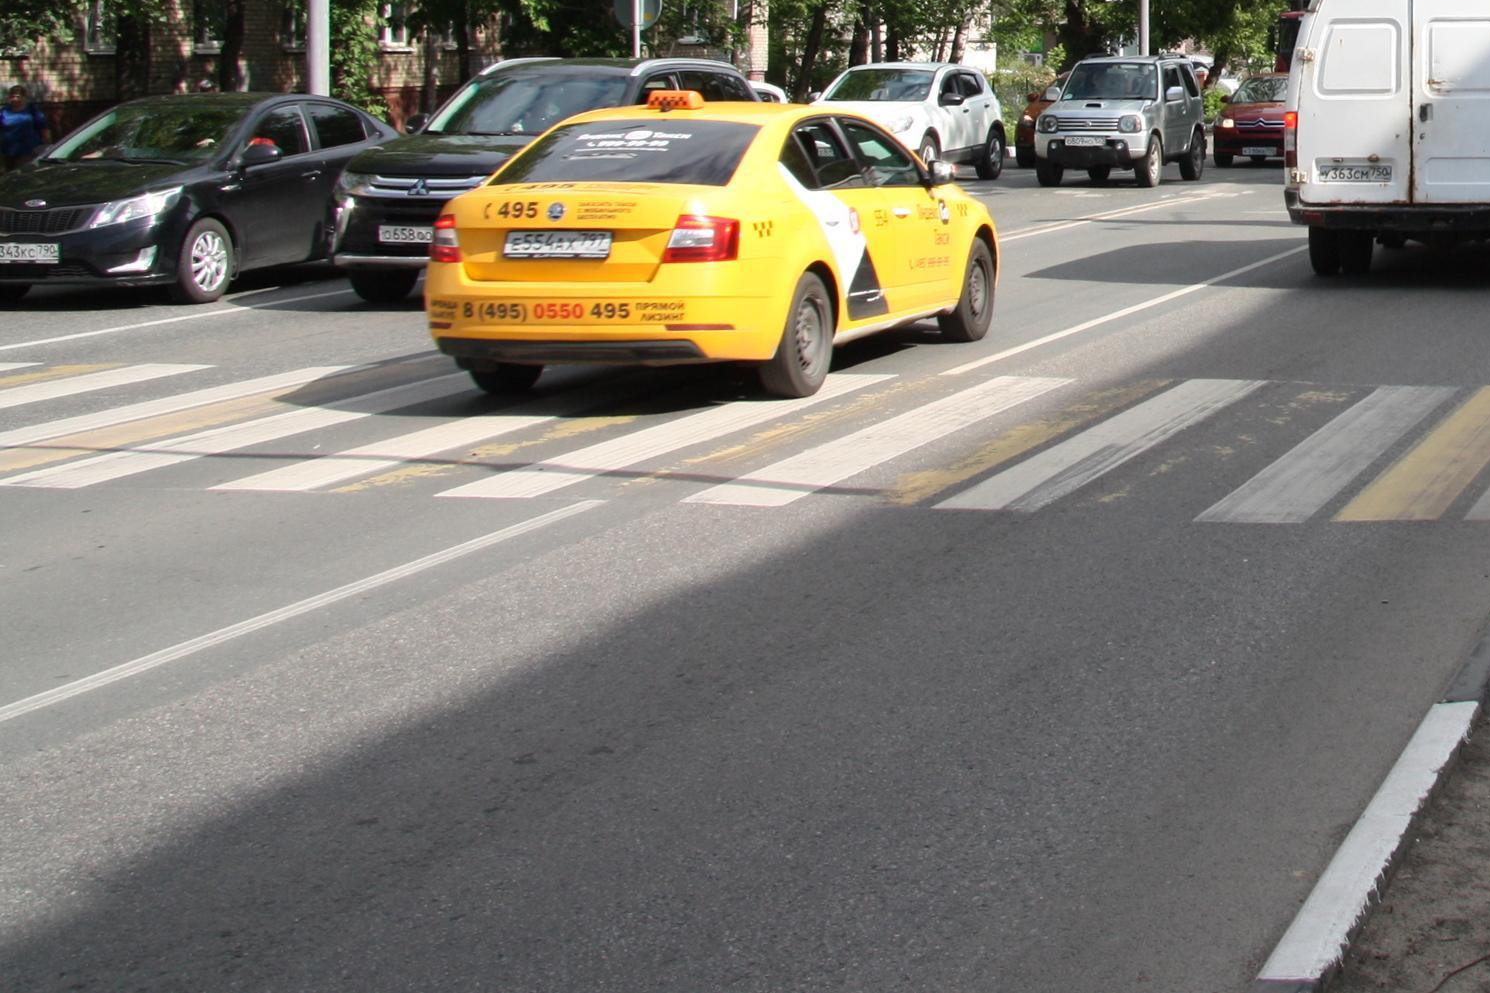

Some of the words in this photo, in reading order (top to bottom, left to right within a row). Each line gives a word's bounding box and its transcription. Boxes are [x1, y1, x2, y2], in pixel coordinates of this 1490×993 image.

[497, 201, 540, 220] 495
[463, 302, 474, 318] 8
[478, 302, 528, 322] (495)
[533, 303, 584, 319] 0550
[590, 302, 630, 319] 495
[635, 299, 685, 311] ПРЯМОЙ
